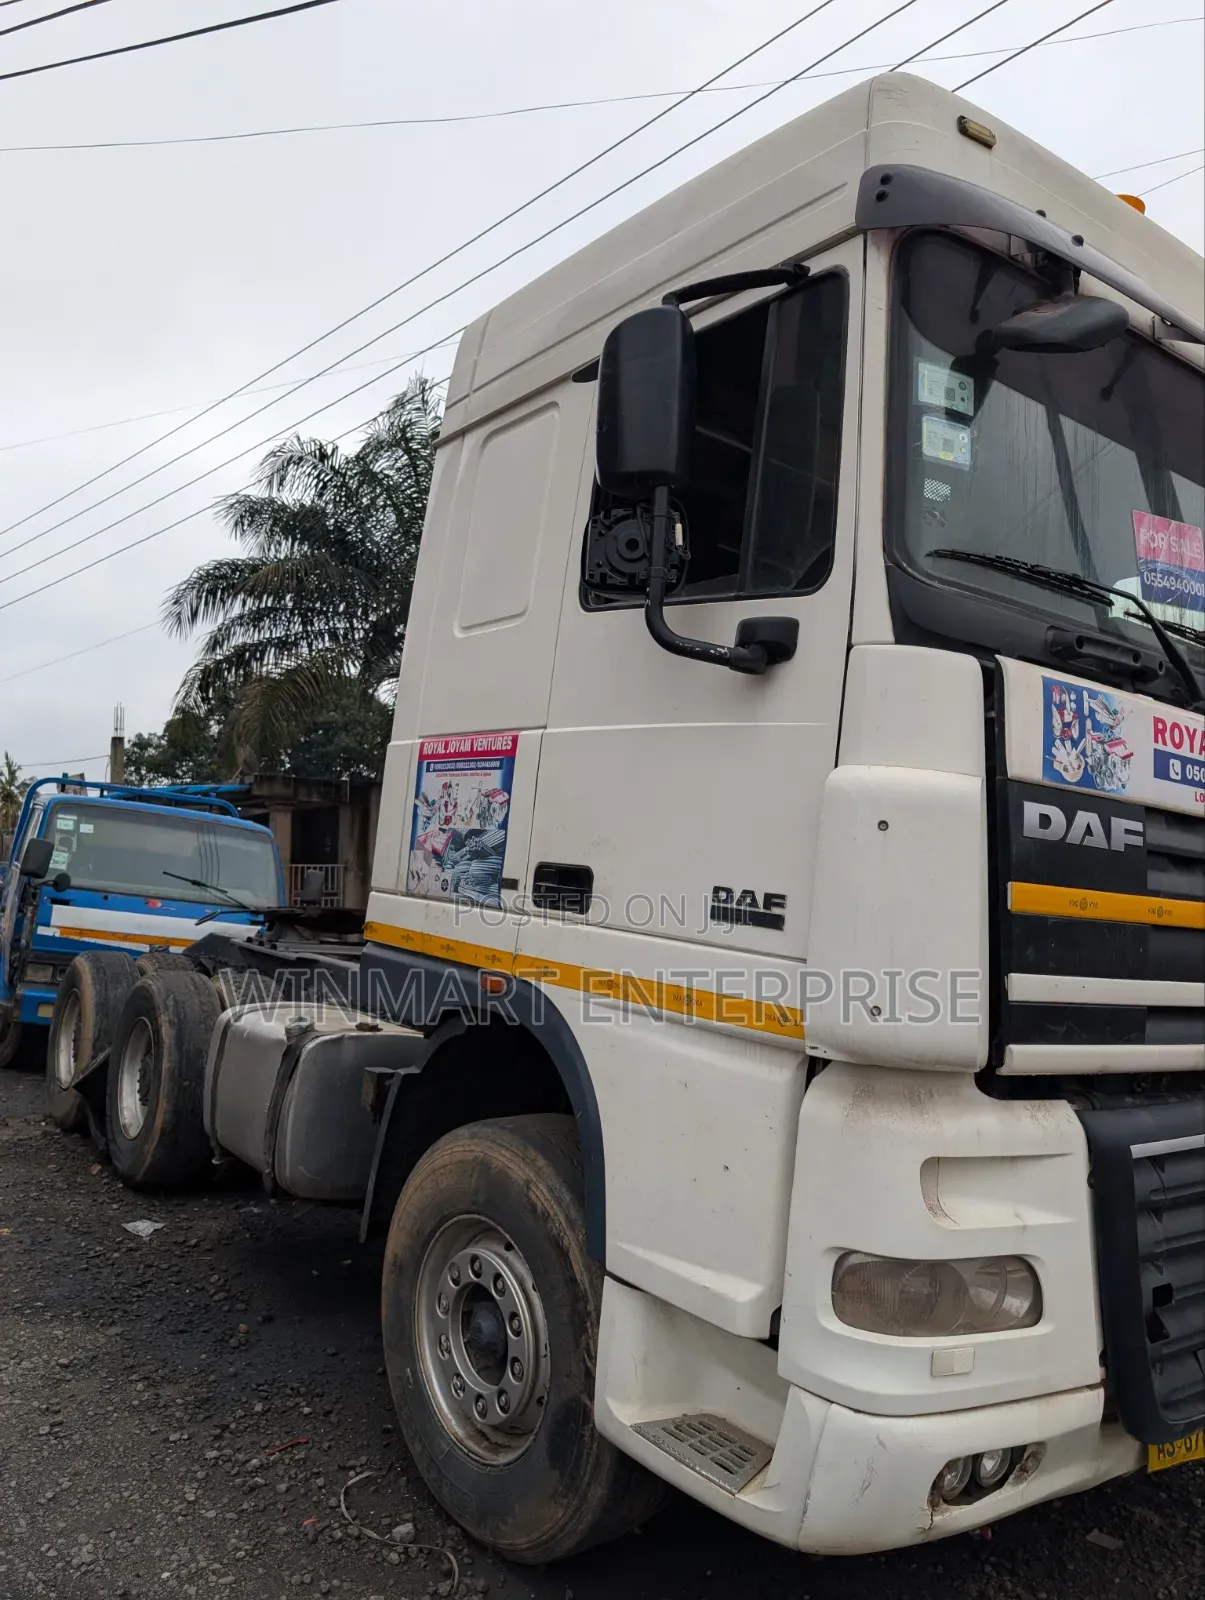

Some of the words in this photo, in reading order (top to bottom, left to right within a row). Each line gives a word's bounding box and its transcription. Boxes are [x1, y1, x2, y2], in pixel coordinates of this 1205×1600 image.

[1139, 528, 1167, 551] FOR
[1169, 535, 1202, 559] SALE
[1143, 571, 1205, 598] 0554940001
[422, 741, 445, 755] ROYAL
[446, 738, 472, 753] JOYAM
[473, 735, 513, 751] VENTURES
[1023, 800, 1144, 852] DAF
[711, 885, 787, 912] DAF
